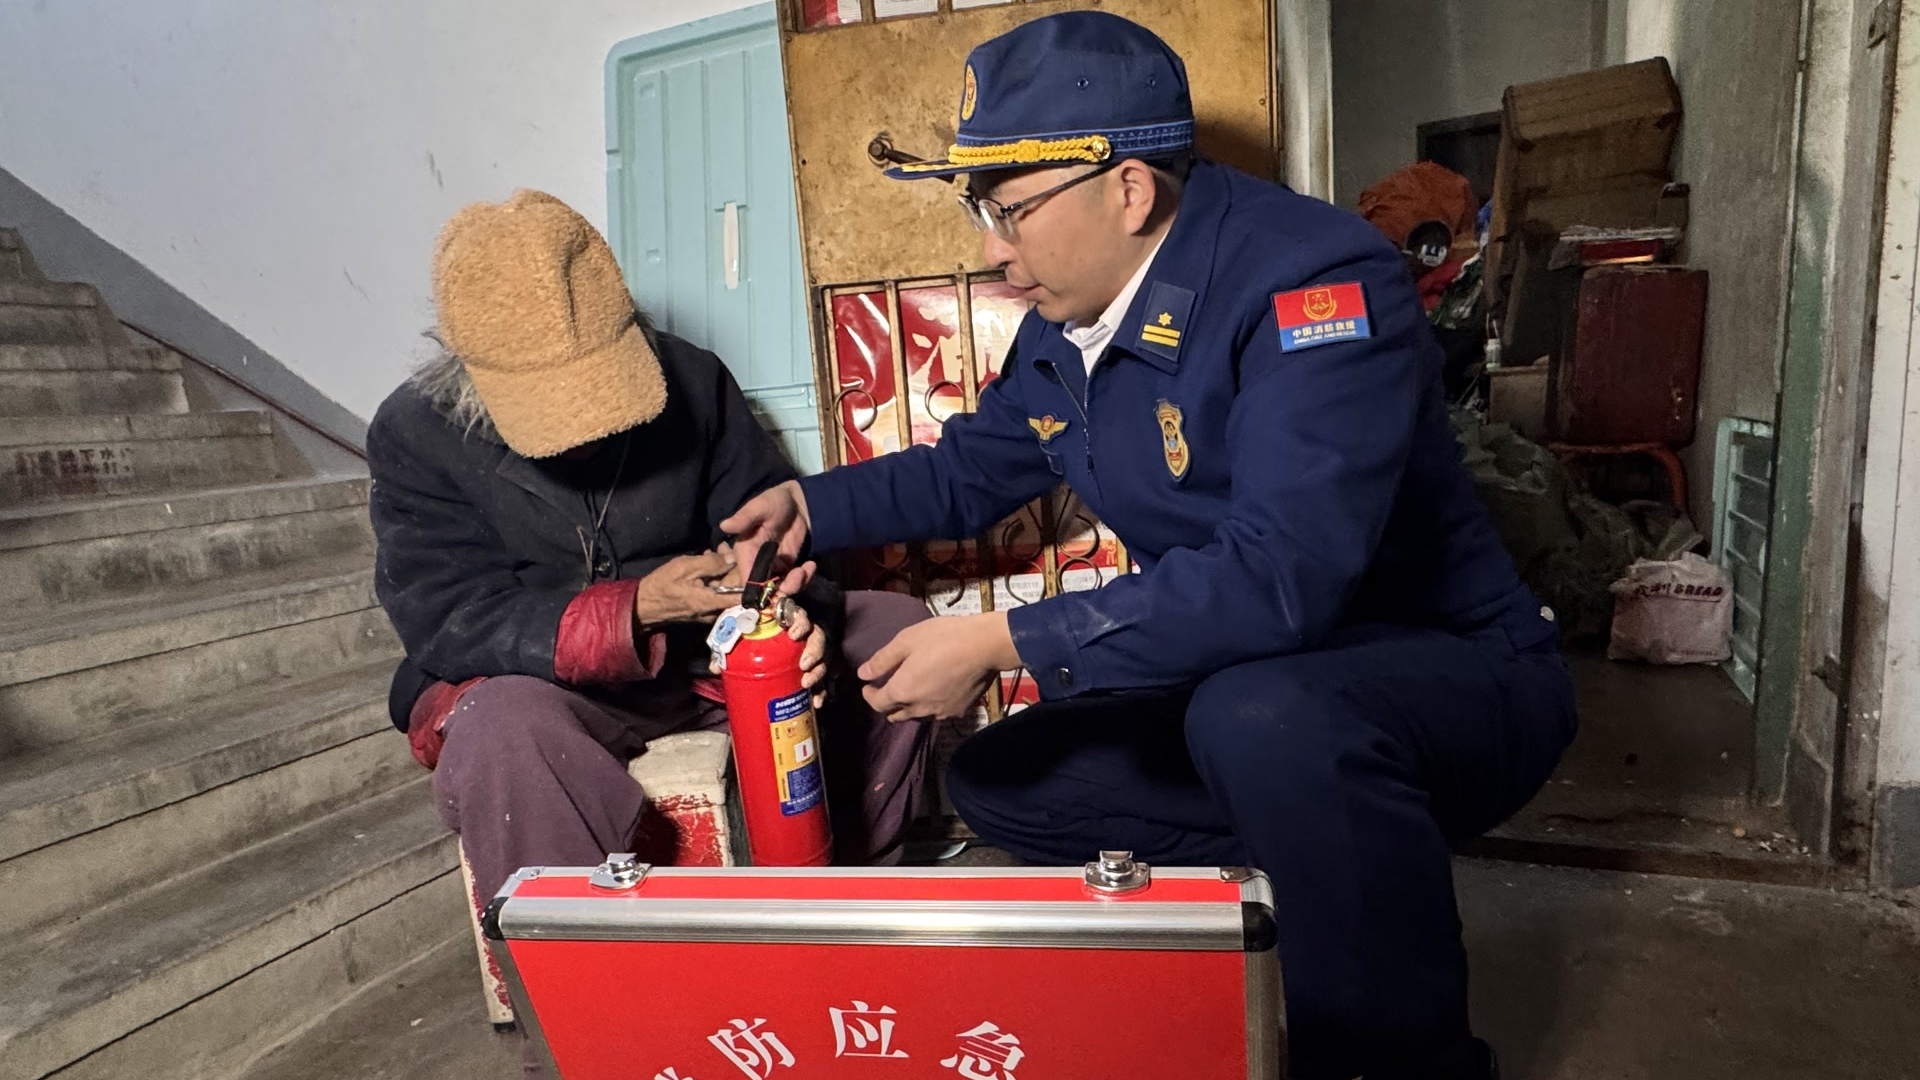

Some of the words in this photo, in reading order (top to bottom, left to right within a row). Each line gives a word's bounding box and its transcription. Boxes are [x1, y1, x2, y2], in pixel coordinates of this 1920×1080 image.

[1293, 320, 1355, 338] 中国消防救援
[1674, 583, 1723, 596] BREAD
[654, 1000, 1026, 1080] 防应急
